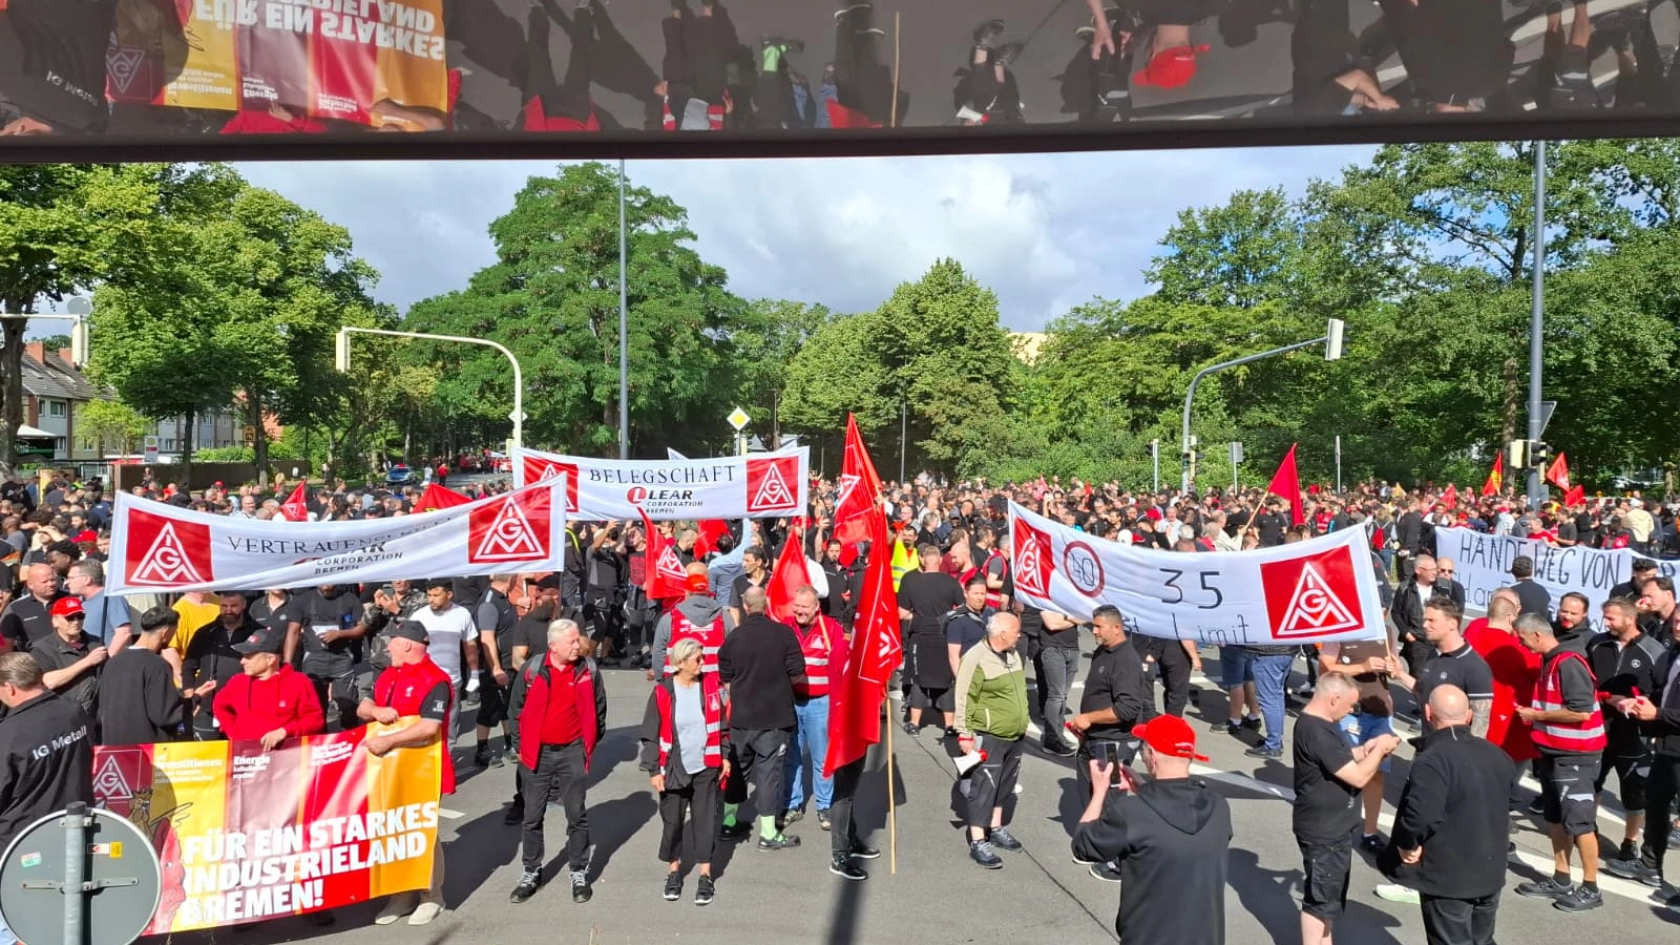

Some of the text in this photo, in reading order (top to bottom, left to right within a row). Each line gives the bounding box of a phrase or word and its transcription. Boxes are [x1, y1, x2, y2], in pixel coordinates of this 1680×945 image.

[590, 465, 736, 484] BELEGSCHAFT
[648, 489, 693, 500] LEAR
[316, 551, 403, 566] CORPORATION
[1533, 543, 1577, 585] WEG
[1581, 551, 1621, 590] VON
[32, 725, 87, 761] IG Metall
[184, 801, 438, 863] FÜR EIN STARKES
[184, 832, 427, 893] INDUSTRIELAND
[181, 879, 324, 926] BREMEN!
